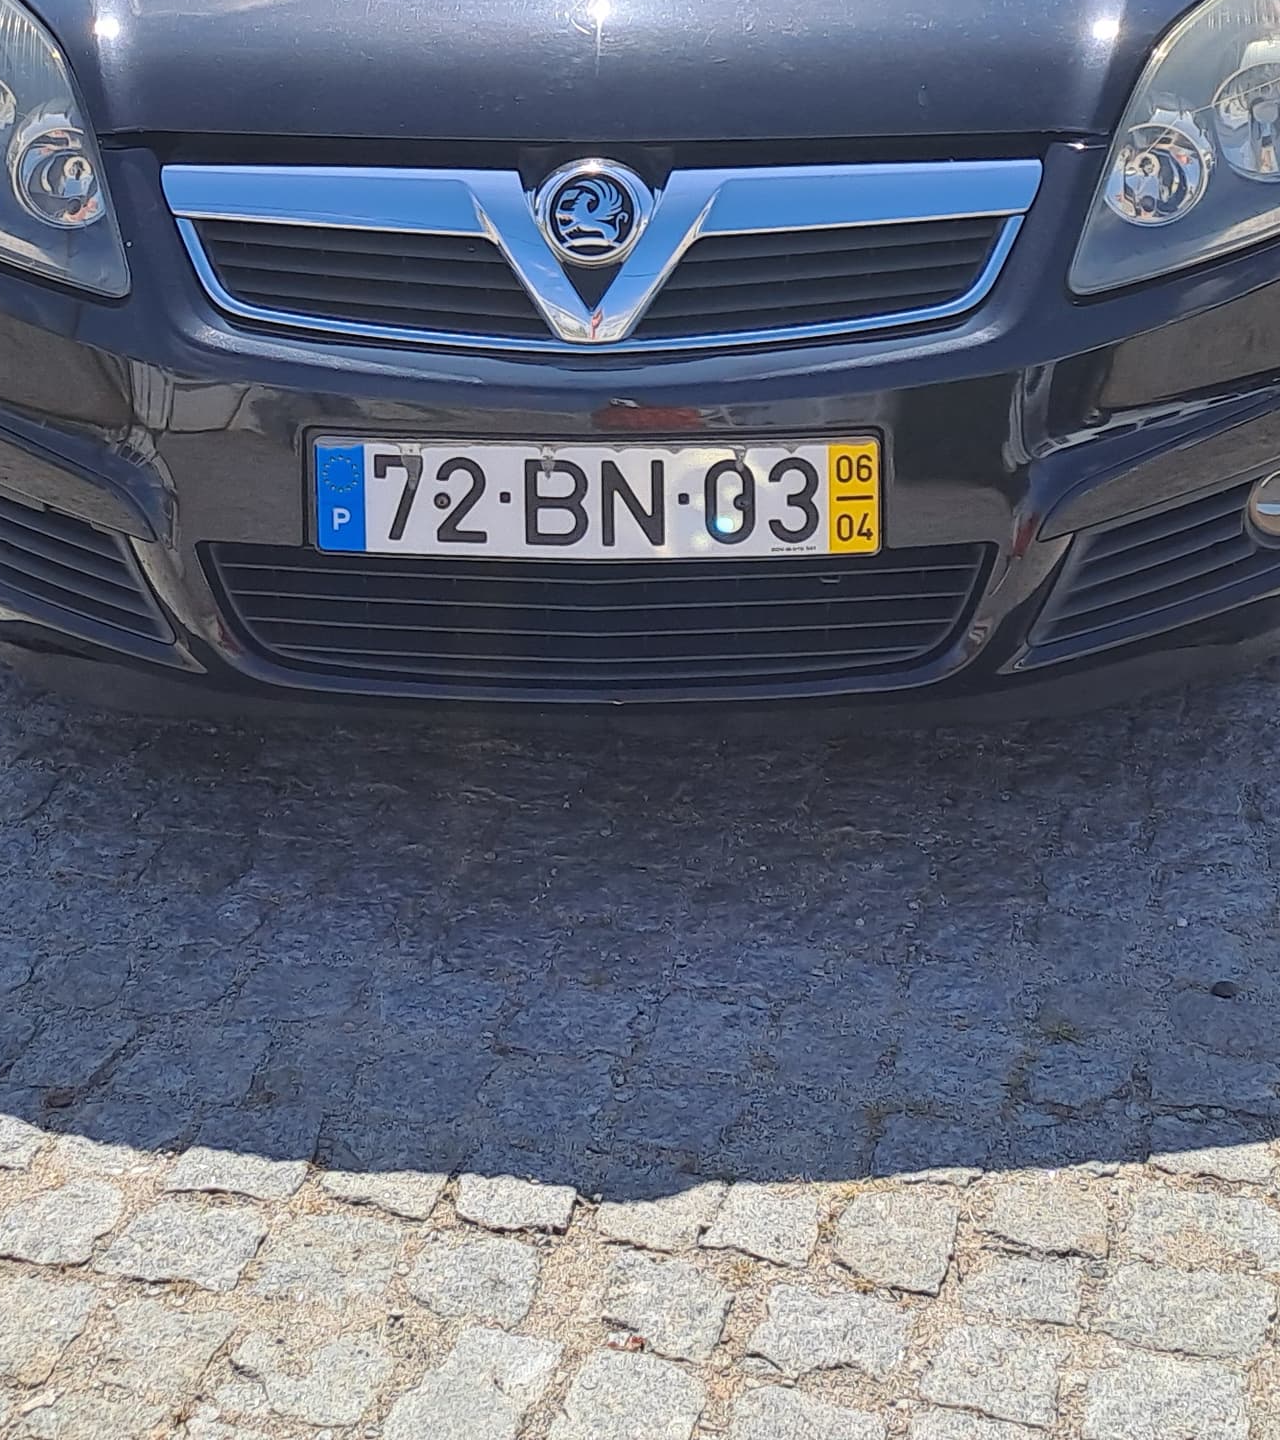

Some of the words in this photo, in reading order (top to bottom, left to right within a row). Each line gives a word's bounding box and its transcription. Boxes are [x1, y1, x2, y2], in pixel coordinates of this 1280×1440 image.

[835, 454, 874, 483] 06
[333, 507, 352, 531] P
[836, 512, 874, 542] 04
